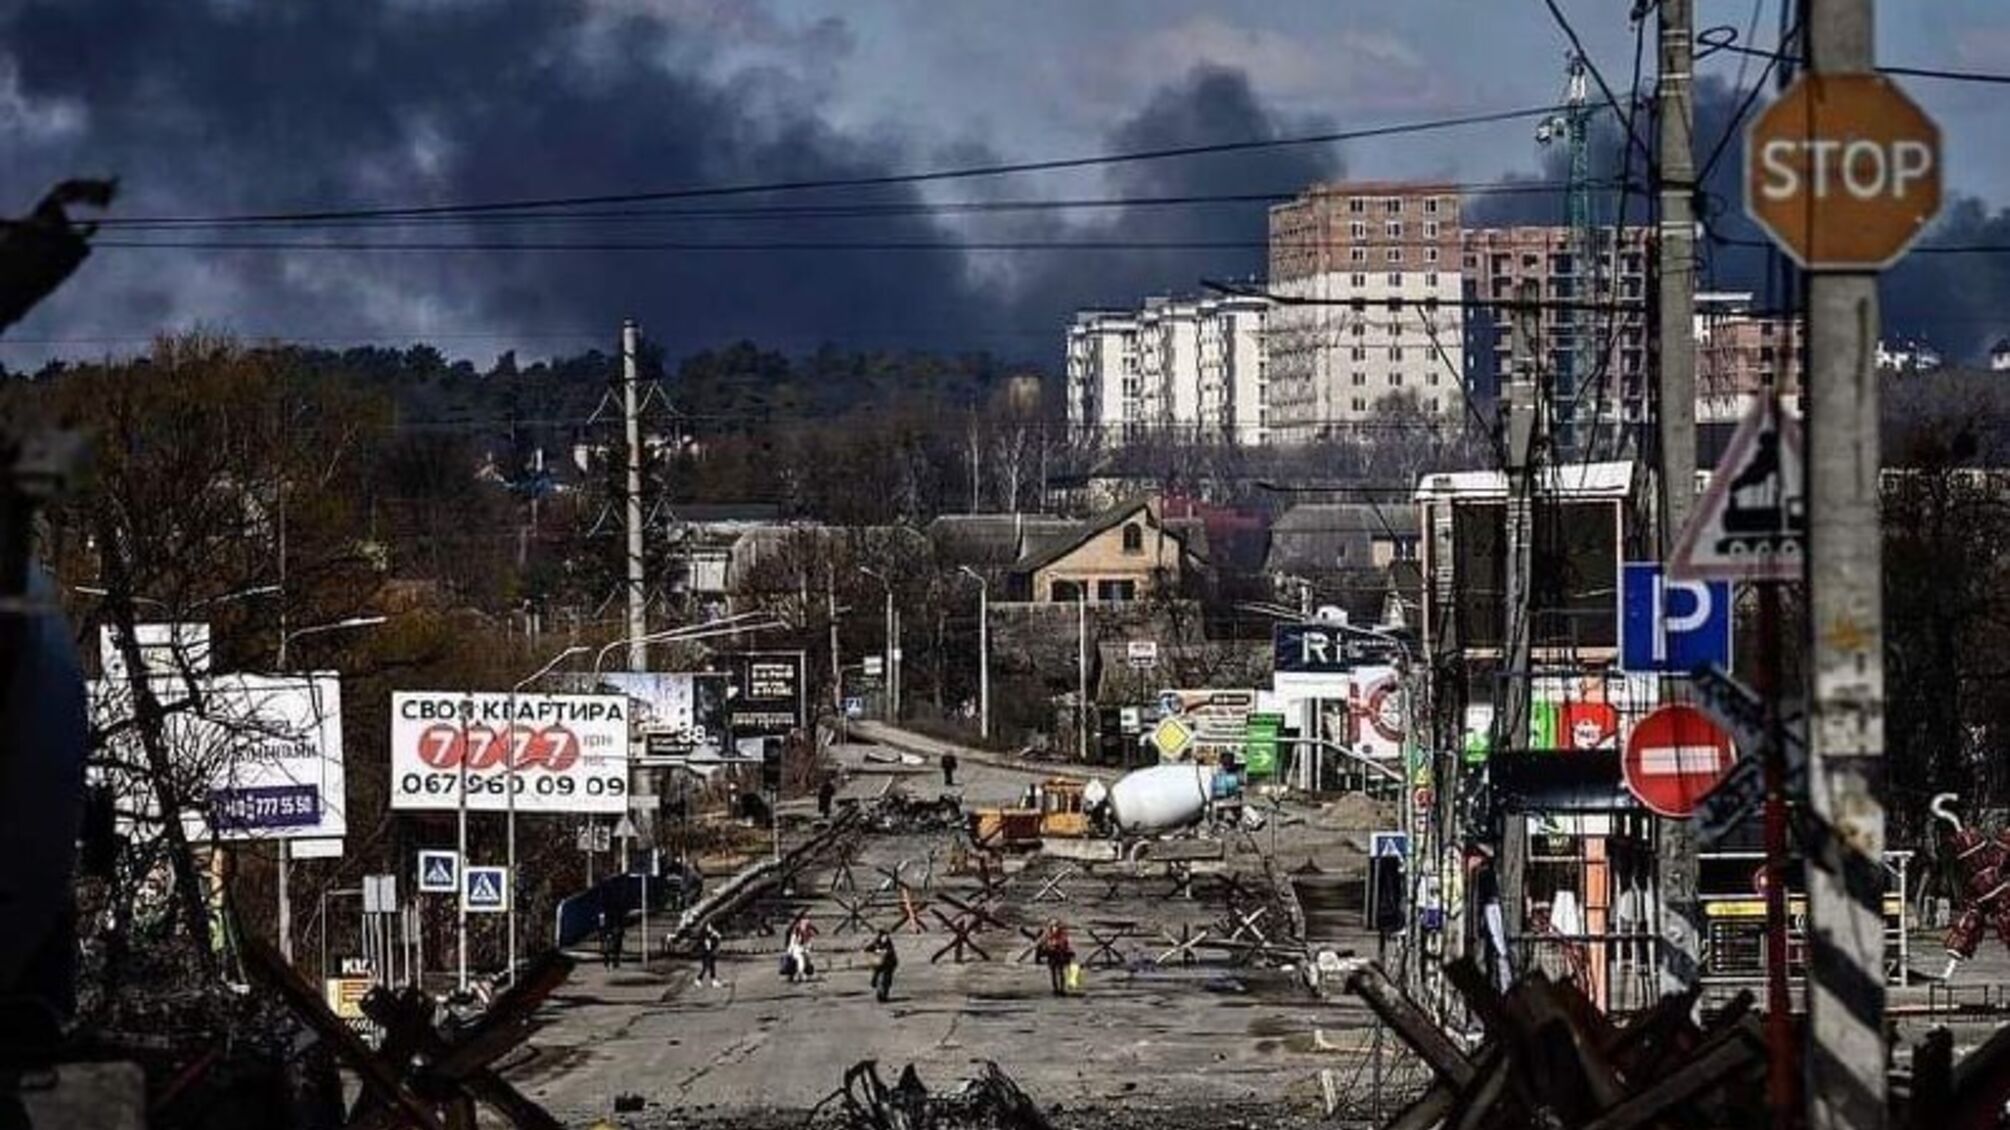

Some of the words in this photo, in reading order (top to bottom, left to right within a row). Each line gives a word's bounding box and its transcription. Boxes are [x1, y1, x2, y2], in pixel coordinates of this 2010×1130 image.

[1763, 141, 1932, 198] STOP
[1652, 574, 1711, 660] P
[401, 700, 475, 720] СВОЯ
[483, 701, 624, 722] КВАРТИРА
[401, 773, 457, 795] 067
[466, 774, 525, 796] 960
[536, 776, 576, 796] 09
[586, 776, 625, 796] 09
